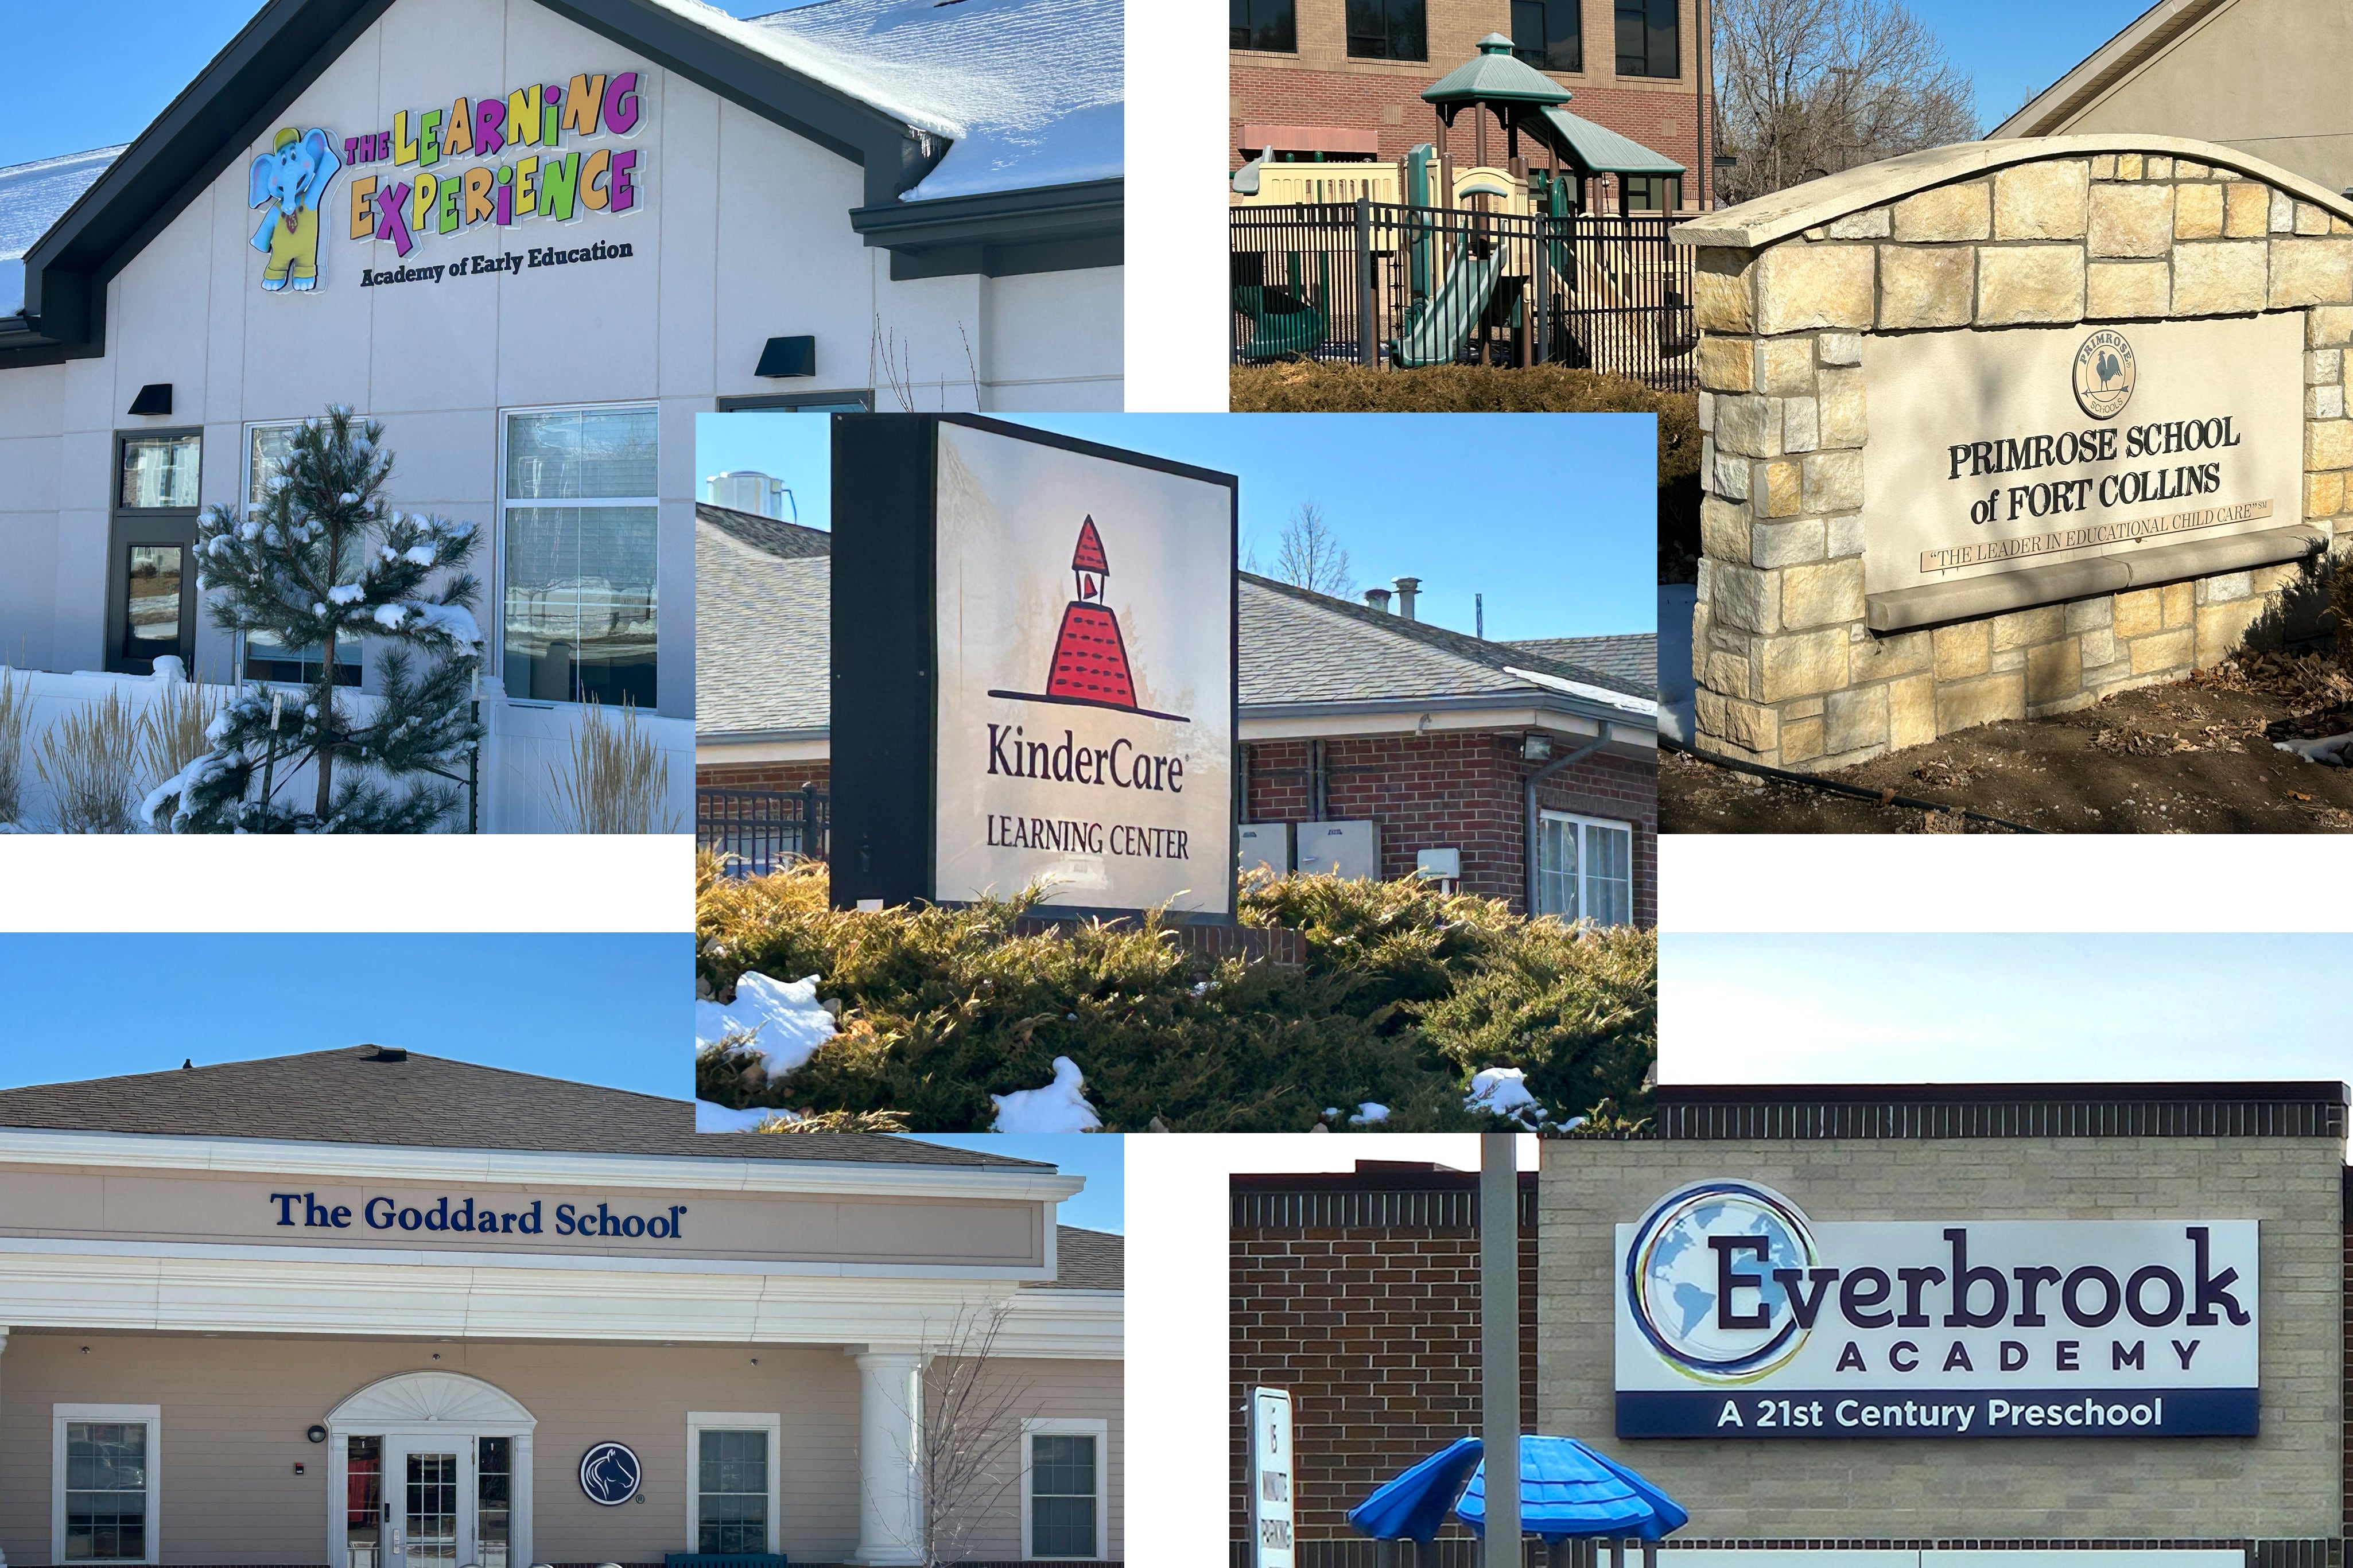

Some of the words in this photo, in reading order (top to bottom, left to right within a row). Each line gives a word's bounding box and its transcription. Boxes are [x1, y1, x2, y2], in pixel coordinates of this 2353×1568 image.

[344, 131, 390, 166] THE
[360, 262, 444, 287] Academy
[449, 261, 468, 276] of
[471, 252, 523, 275] Early
[528, 240, 633, 267] Education
[2090, 398, 2123, 413] SCHOOLS
[1948, 427, 2118, 480] PRIMROSE
[2126, 416, 2241, 457] SCHOOL
[1971, 490, 1999, 525] of
[2007, 478, 2092, 521] FORT
[2099, 462, 2220, 507] COLLINS
[1977, 537, 2042, 561] LEADER
[2047, 534, 2063, 549] IN
[2067, 516, 2169, 546] EDUCATIONAL
[2173, 510, 2214, 531] CHILD
[987, 723, 1183, 793] KinderCare
[987, 814, 1103, 854] LEARNING
[1110, 824, 1189, 859] CENTER
[270, 1193, 352, 1228] The
[364, 1197, 543, 1234] Goddard
[1707, 1228, 2251, 1330] Everbrook
[1836, 1340, 2201, 1372] ACADEMY
[1718, 1402, 1744, 1427] A
[1757, 1400, 1823, 1427] 21st
[1835, 1400, 1975, 1432] Century
[1989, 1398, 2162, 1426] Preschool
